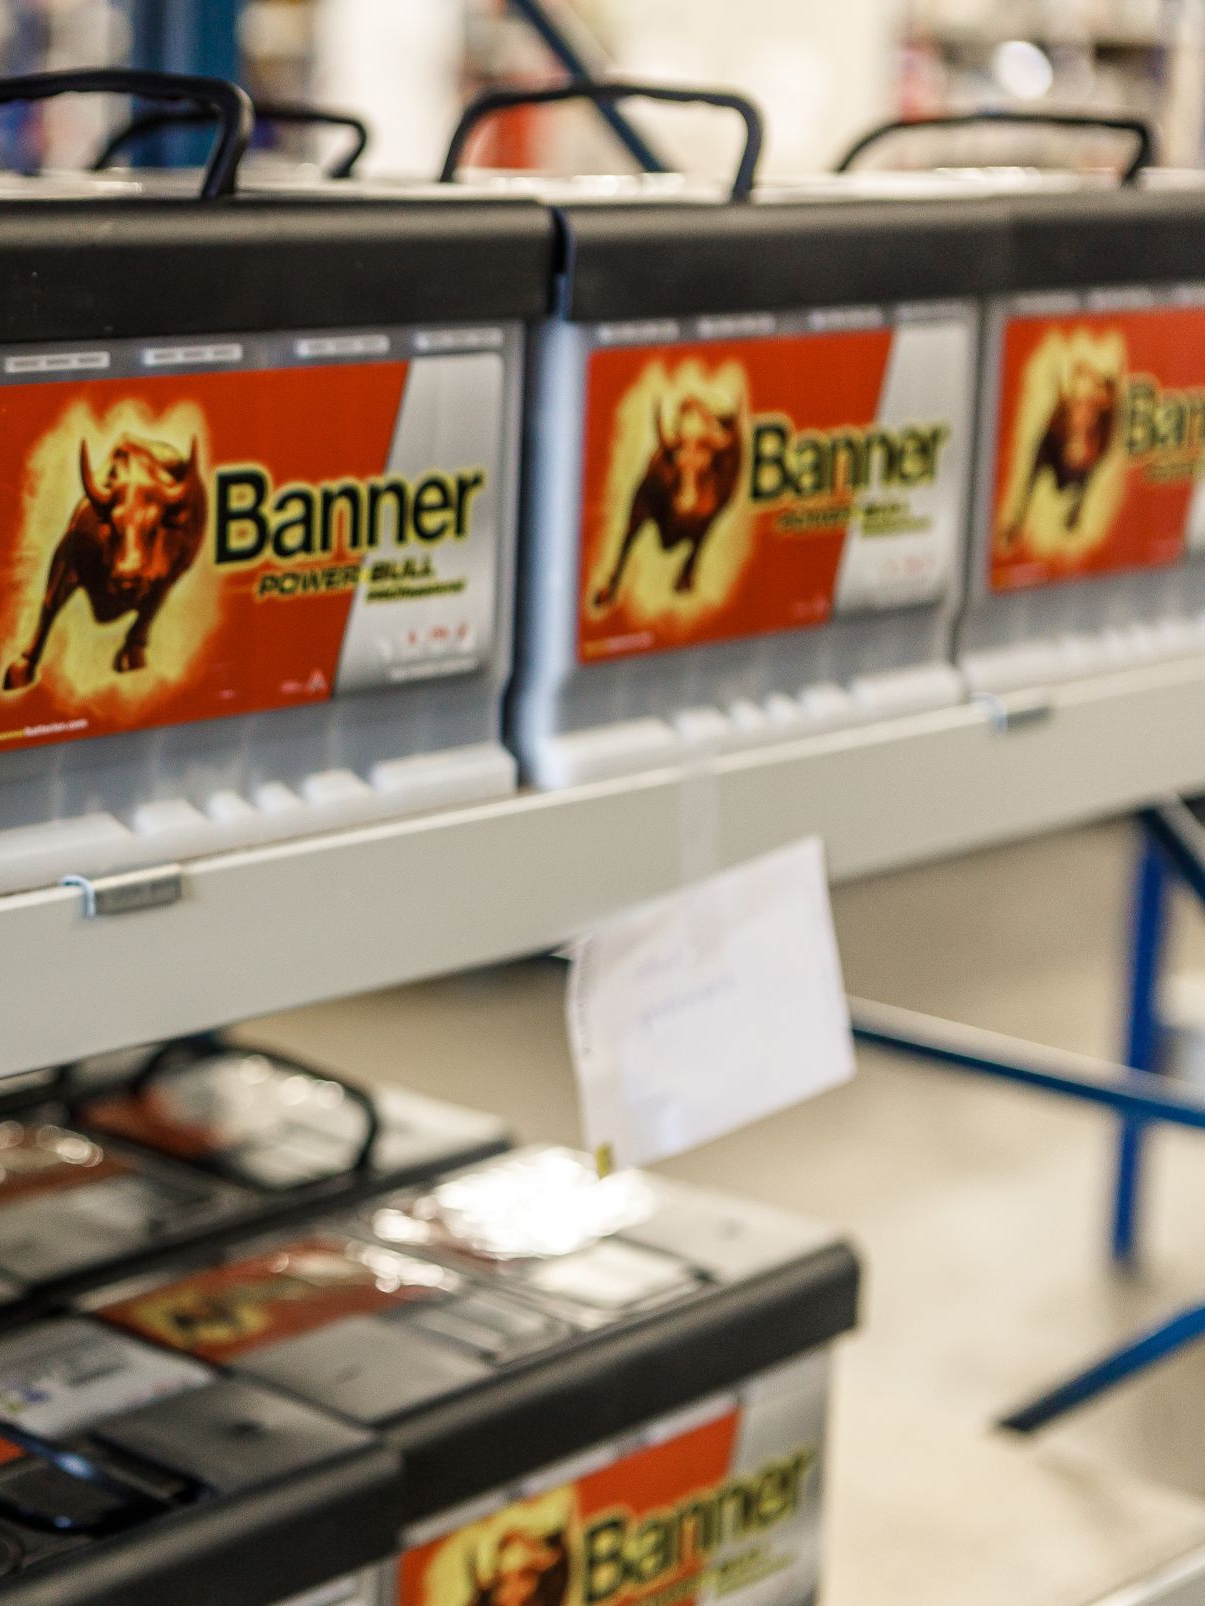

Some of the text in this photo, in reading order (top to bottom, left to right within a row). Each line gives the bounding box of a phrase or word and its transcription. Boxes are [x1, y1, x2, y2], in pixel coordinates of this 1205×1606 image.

[752, 422, 952, 501] Banner
[214, 469, 483, 565] Banner
[583, 1448, 814, 1601] Banner
